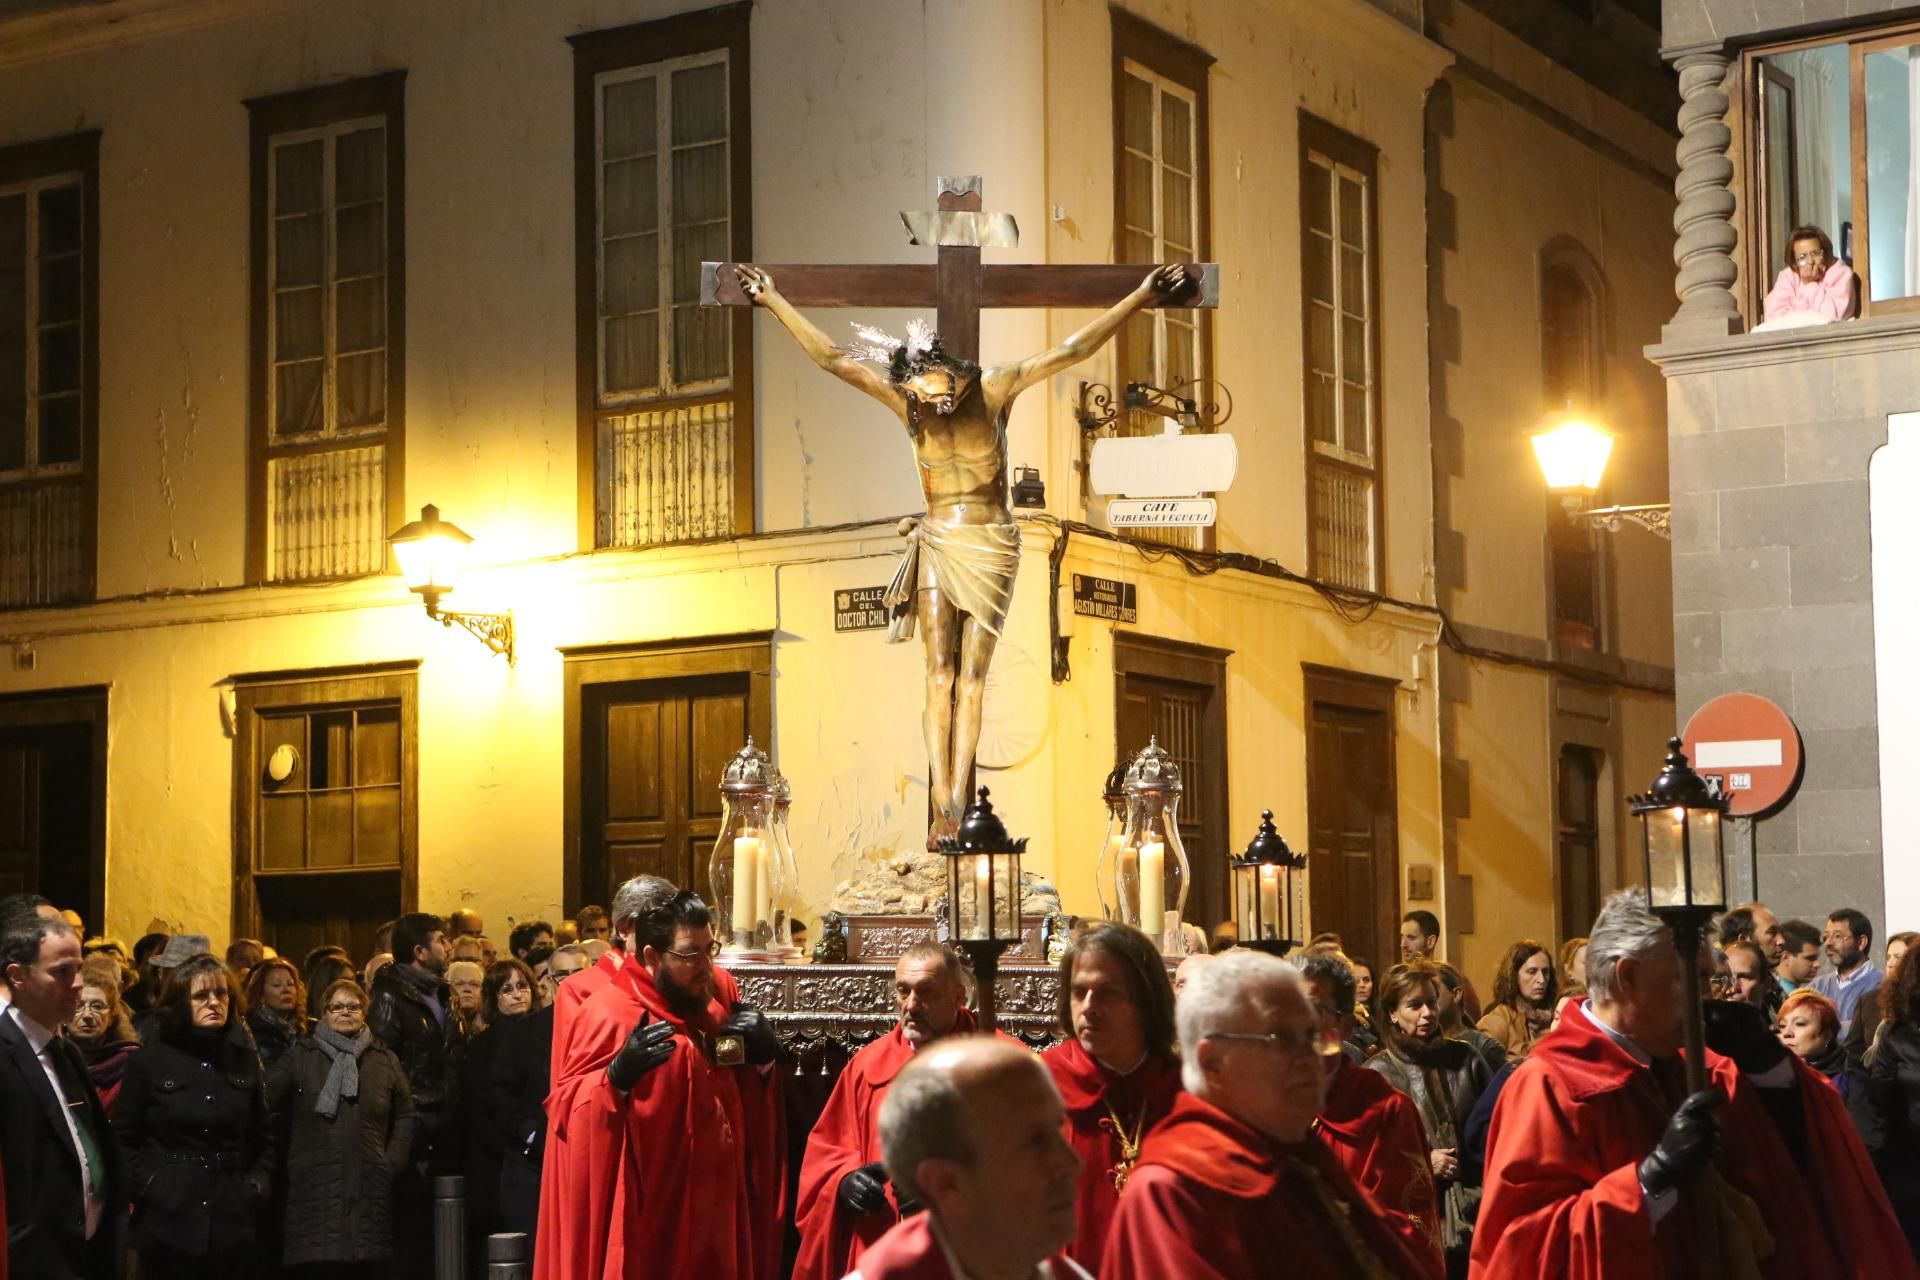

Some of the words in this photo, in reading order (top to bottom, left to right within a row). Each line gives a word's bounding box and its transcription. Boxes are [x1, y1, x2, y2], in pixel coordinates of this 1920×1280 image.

[1142, 503, 1179, 512] CAFE
[1113, 514, 1159, 522] TABERNA
[1161, 513, 1208, 521] VEGUETA
[1095, 579, 1115, 592] CALLE
[853, 590, 882, 601] CALLE
[1095, 602, 1118, 619] MILLARES
[838, 612, 867, 628] DOCTOR
[869, 610, 886, 625] CHIL
